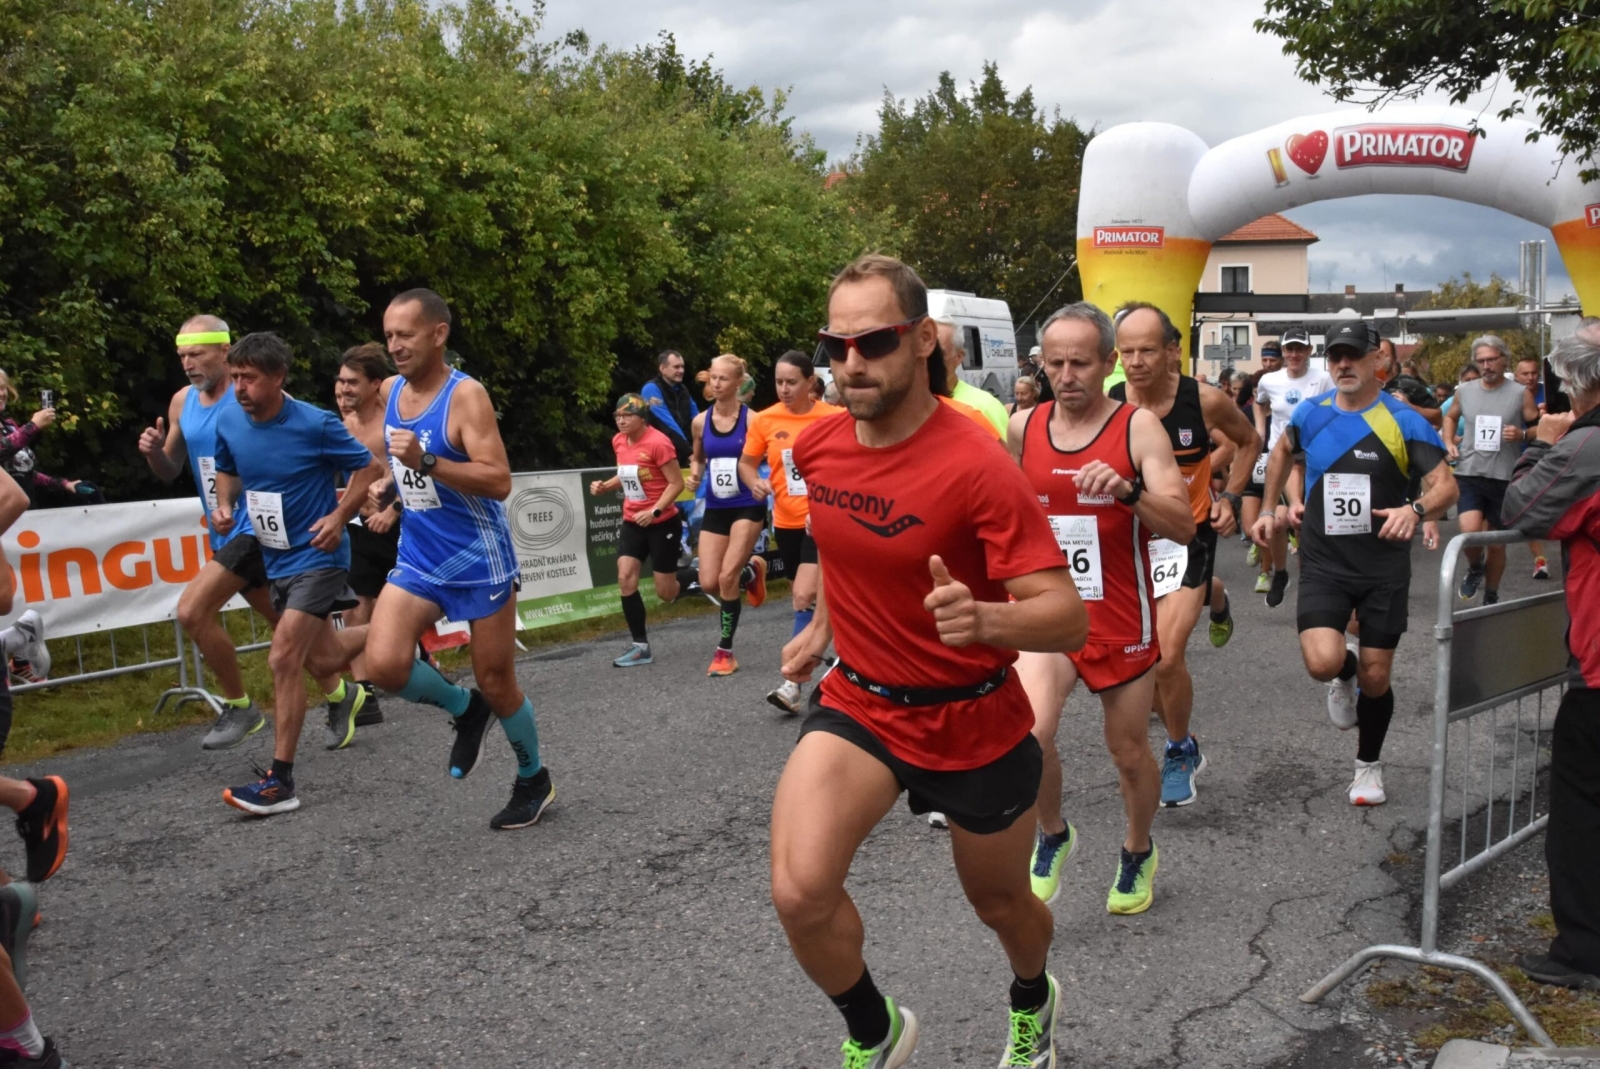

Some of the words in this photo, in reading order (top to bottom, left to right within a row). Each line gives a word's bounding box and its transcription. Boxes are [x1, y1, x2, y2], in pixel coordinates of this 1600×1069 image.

[1480, 429, 1496, 440] 17
[402, 469, 426, 490] 48
[716, 474, 733, 487] 62
[791, 467, 802, 481] 8
[207, 478, 217, 494] 2
[624, 480, 639, 491] 78
[1333, 498, 1361, 516] 30
[256, 513, 279, 532] 16
[527, 511, 553, 524] TREES
[615, 516, 623, 528] pá
[520, 555, 546, 570] HRADNÍ
[547, 553, 577, 566] KAVÁRNA
[521, 568, 545, 584] ERVENÝ
[547, 566, 577, 579] KOSTELEC
[1153, 562, 1179, 583] 64
[524, 602, 574, 621] WWW.TREES.CZ
